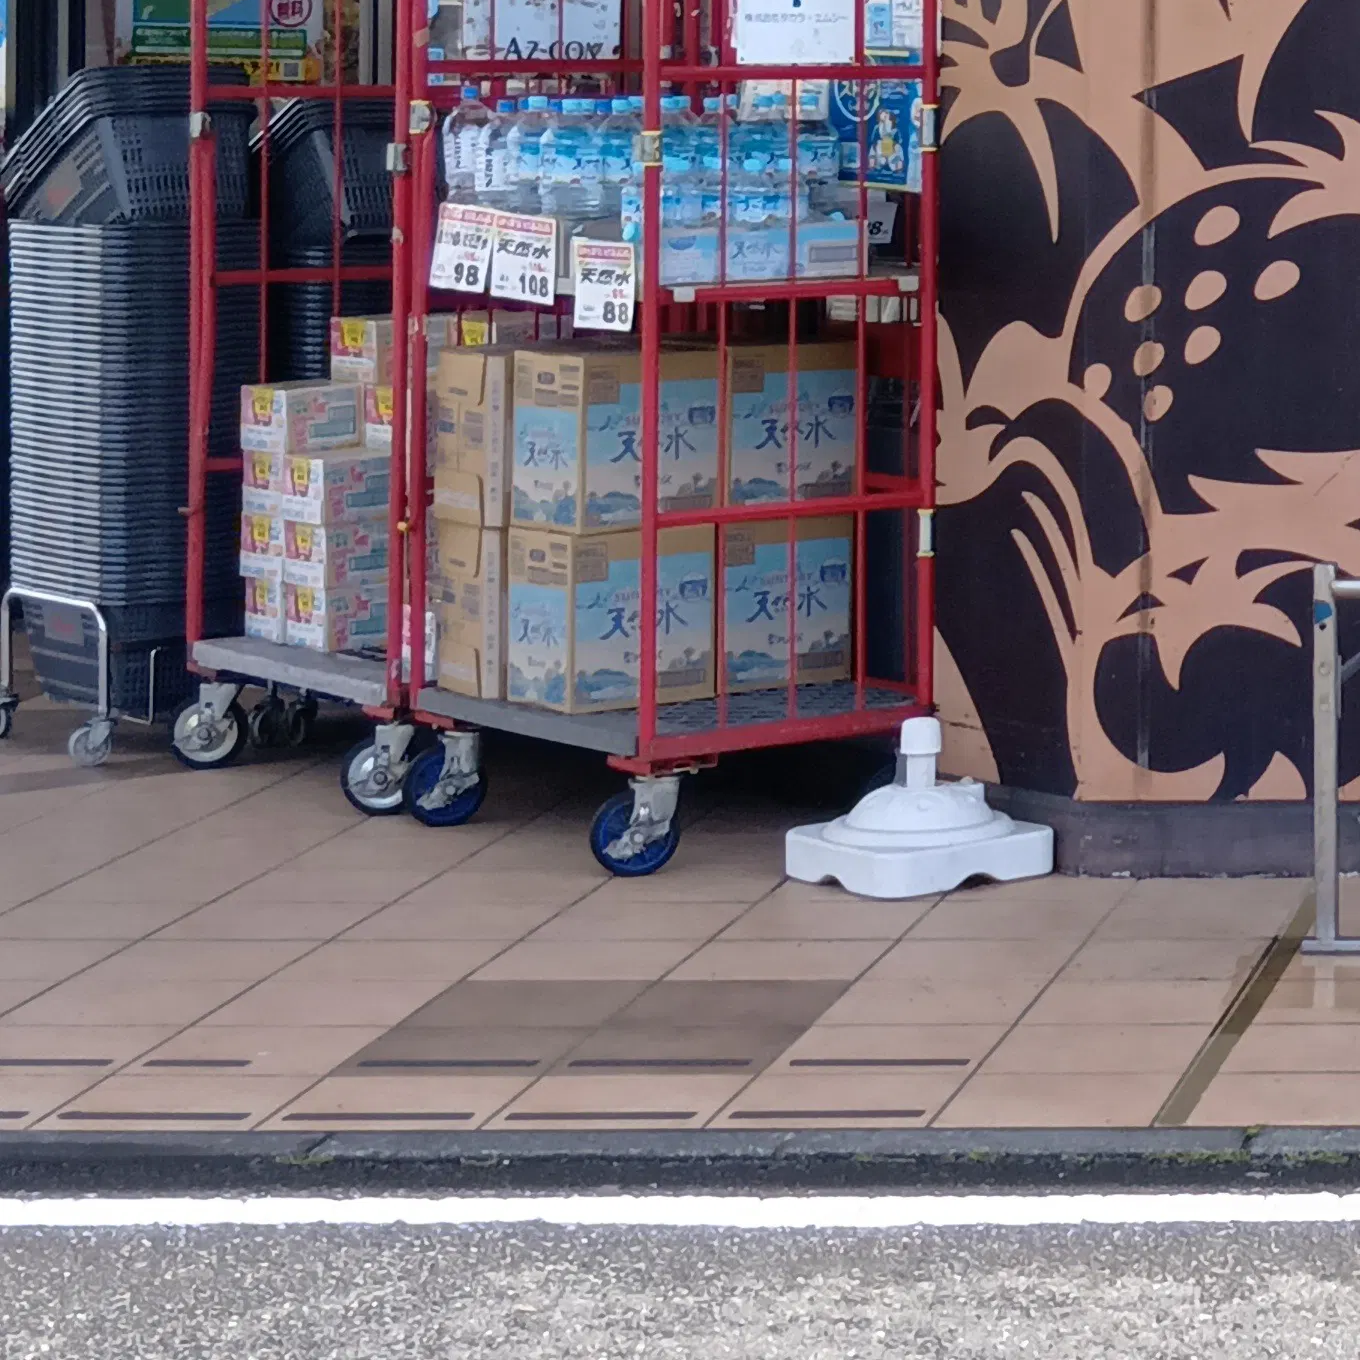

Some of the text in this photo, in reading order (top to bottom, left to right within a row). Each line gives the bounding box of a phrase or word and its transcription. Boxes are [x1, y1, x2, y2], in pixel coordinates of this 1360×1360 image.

[453, 261, 480, 286] 98
[518, 272, 550, 298] 108
[602, 301, 629, 325] 88
